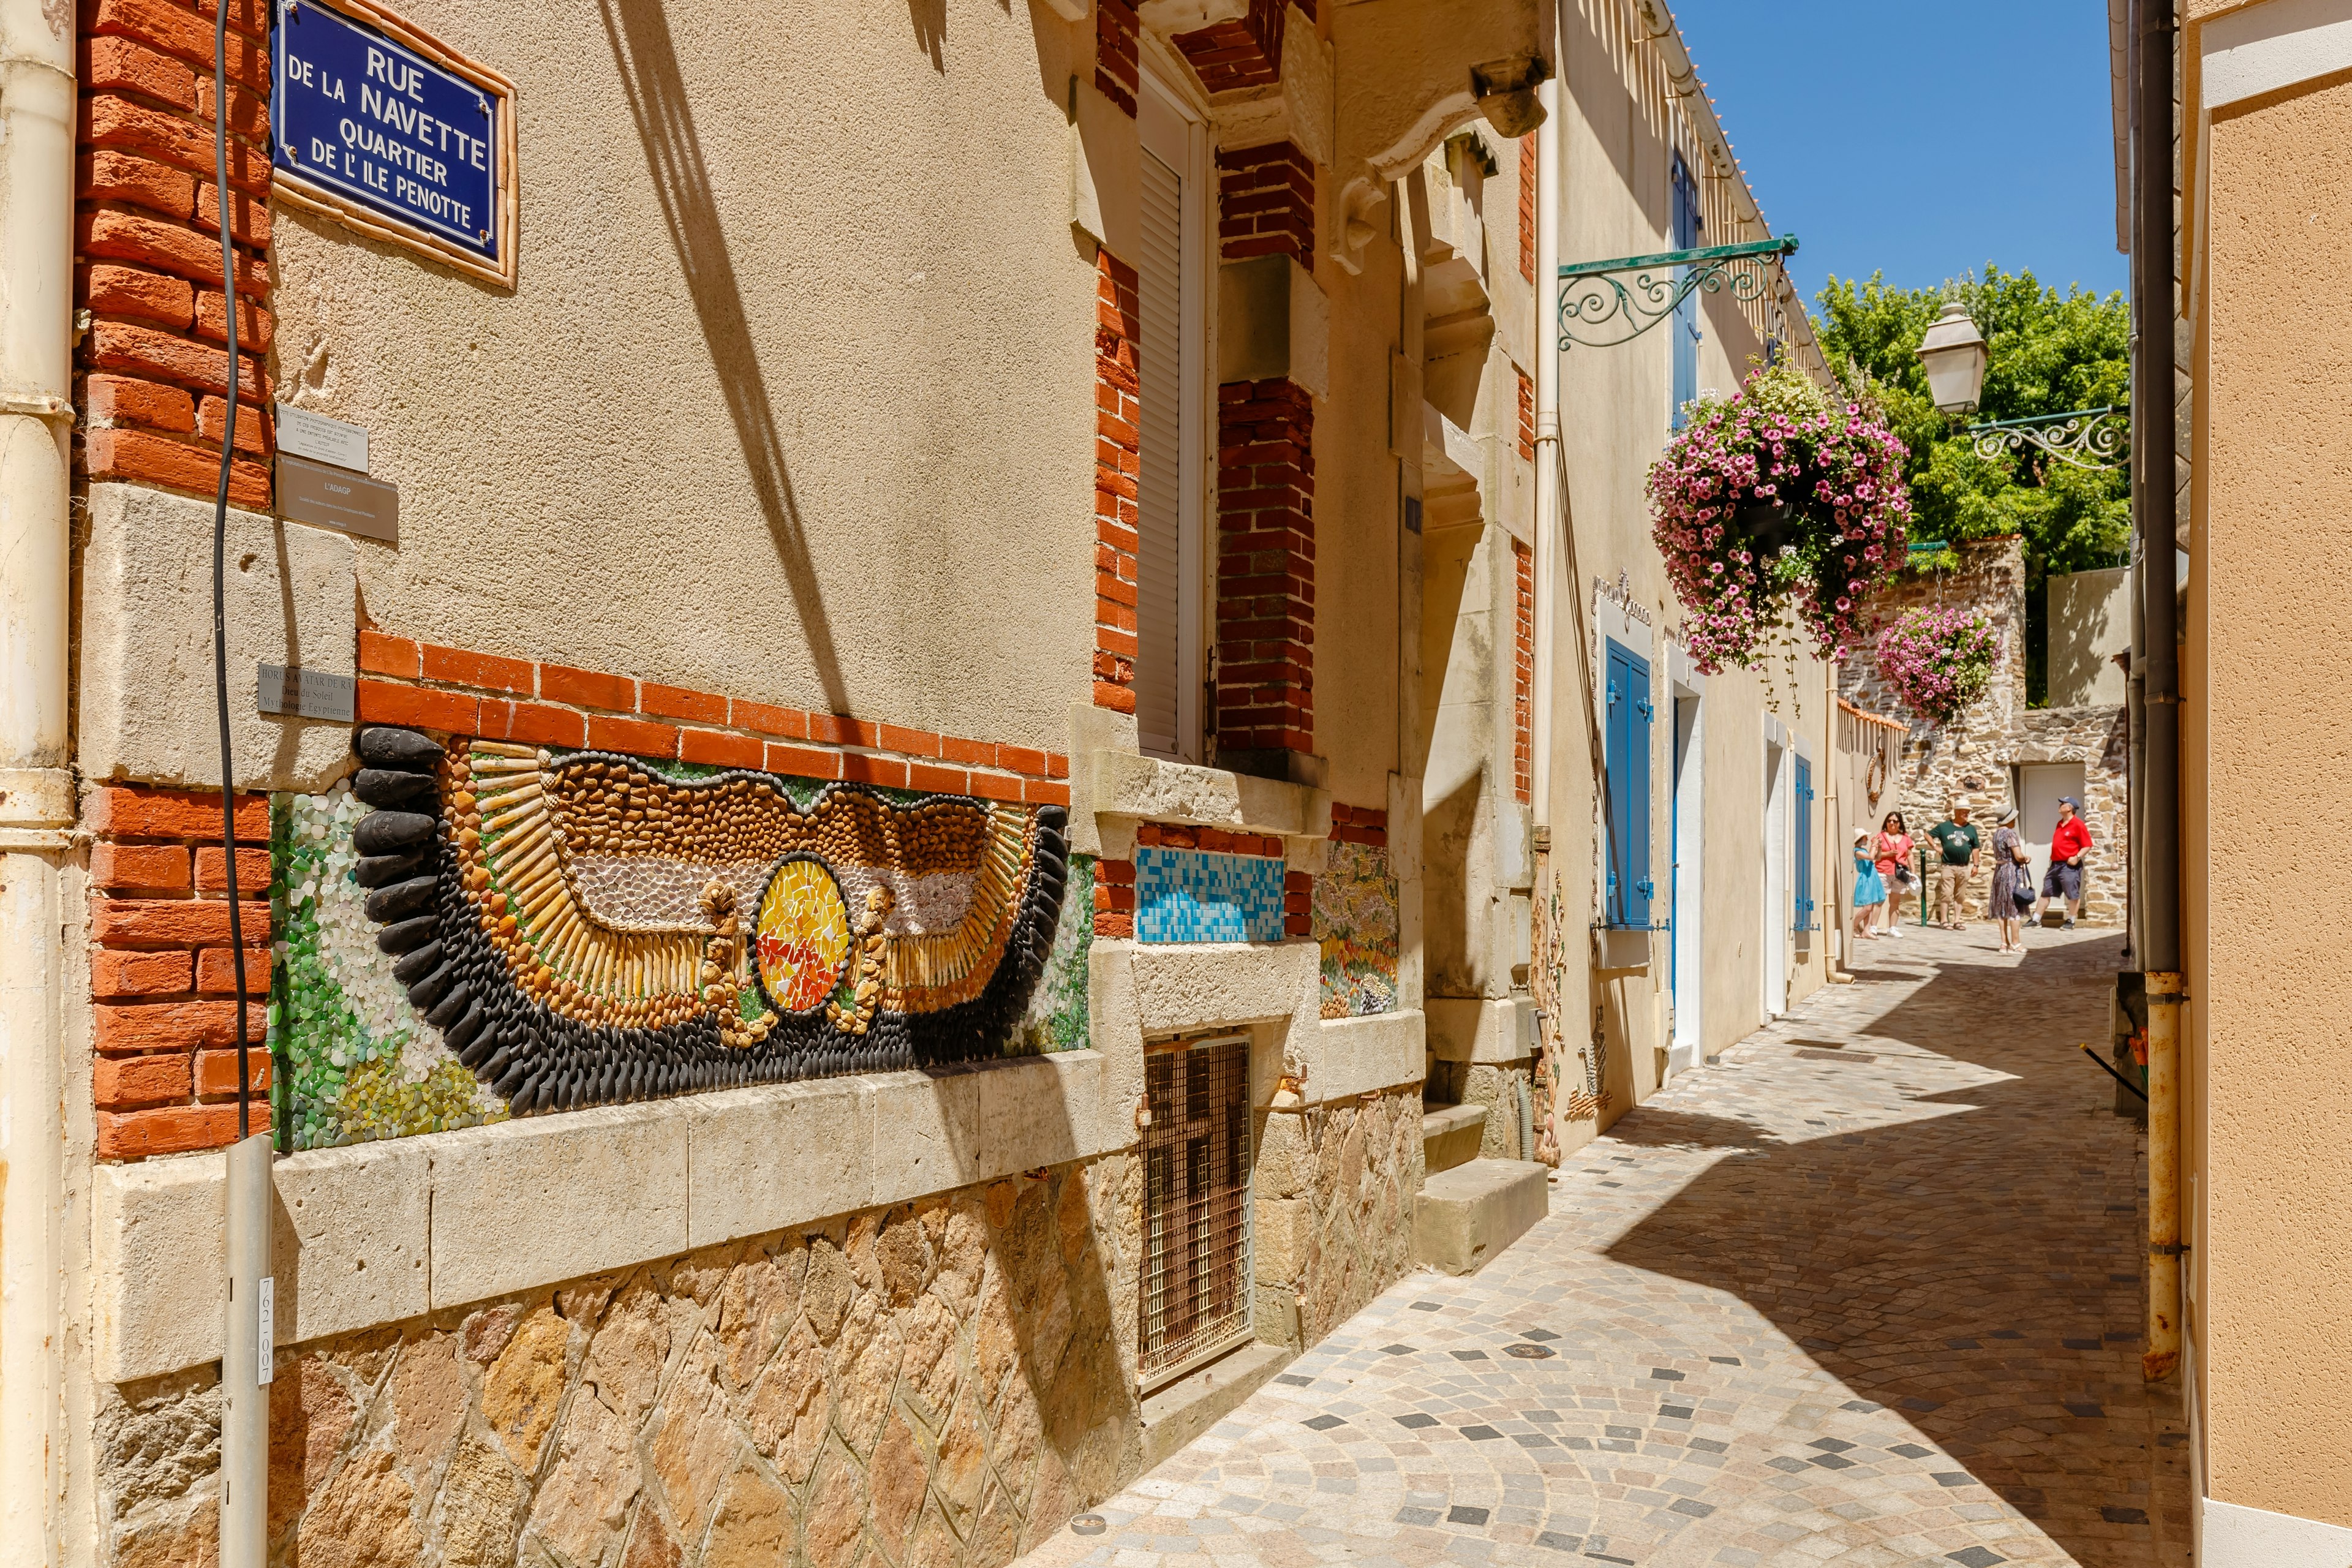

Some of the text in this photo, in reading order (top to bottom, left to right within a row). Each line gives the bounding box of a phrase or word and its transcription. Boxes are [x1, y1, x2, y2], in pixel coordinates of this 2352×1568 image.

[366, 46, 424, 103] RUE
[289, 55, 486, 171] DE LA NAVETTE
[339, 118, 447, 186] QUARTIER
[312, 137, 336, 170] DE
[396, 175, 471, 229] PENOTTE
[325, 482, 351, 495] L'ADAGP
[262, 669, 290, 681] HORUS
[293, 674, 325, 686] AVATAR
[328, 678, 338, 688] DE
[282, 685, 333, 701] Dieu du Soleil
[264, 696, 350, 716] Mythologie Egyptienne
